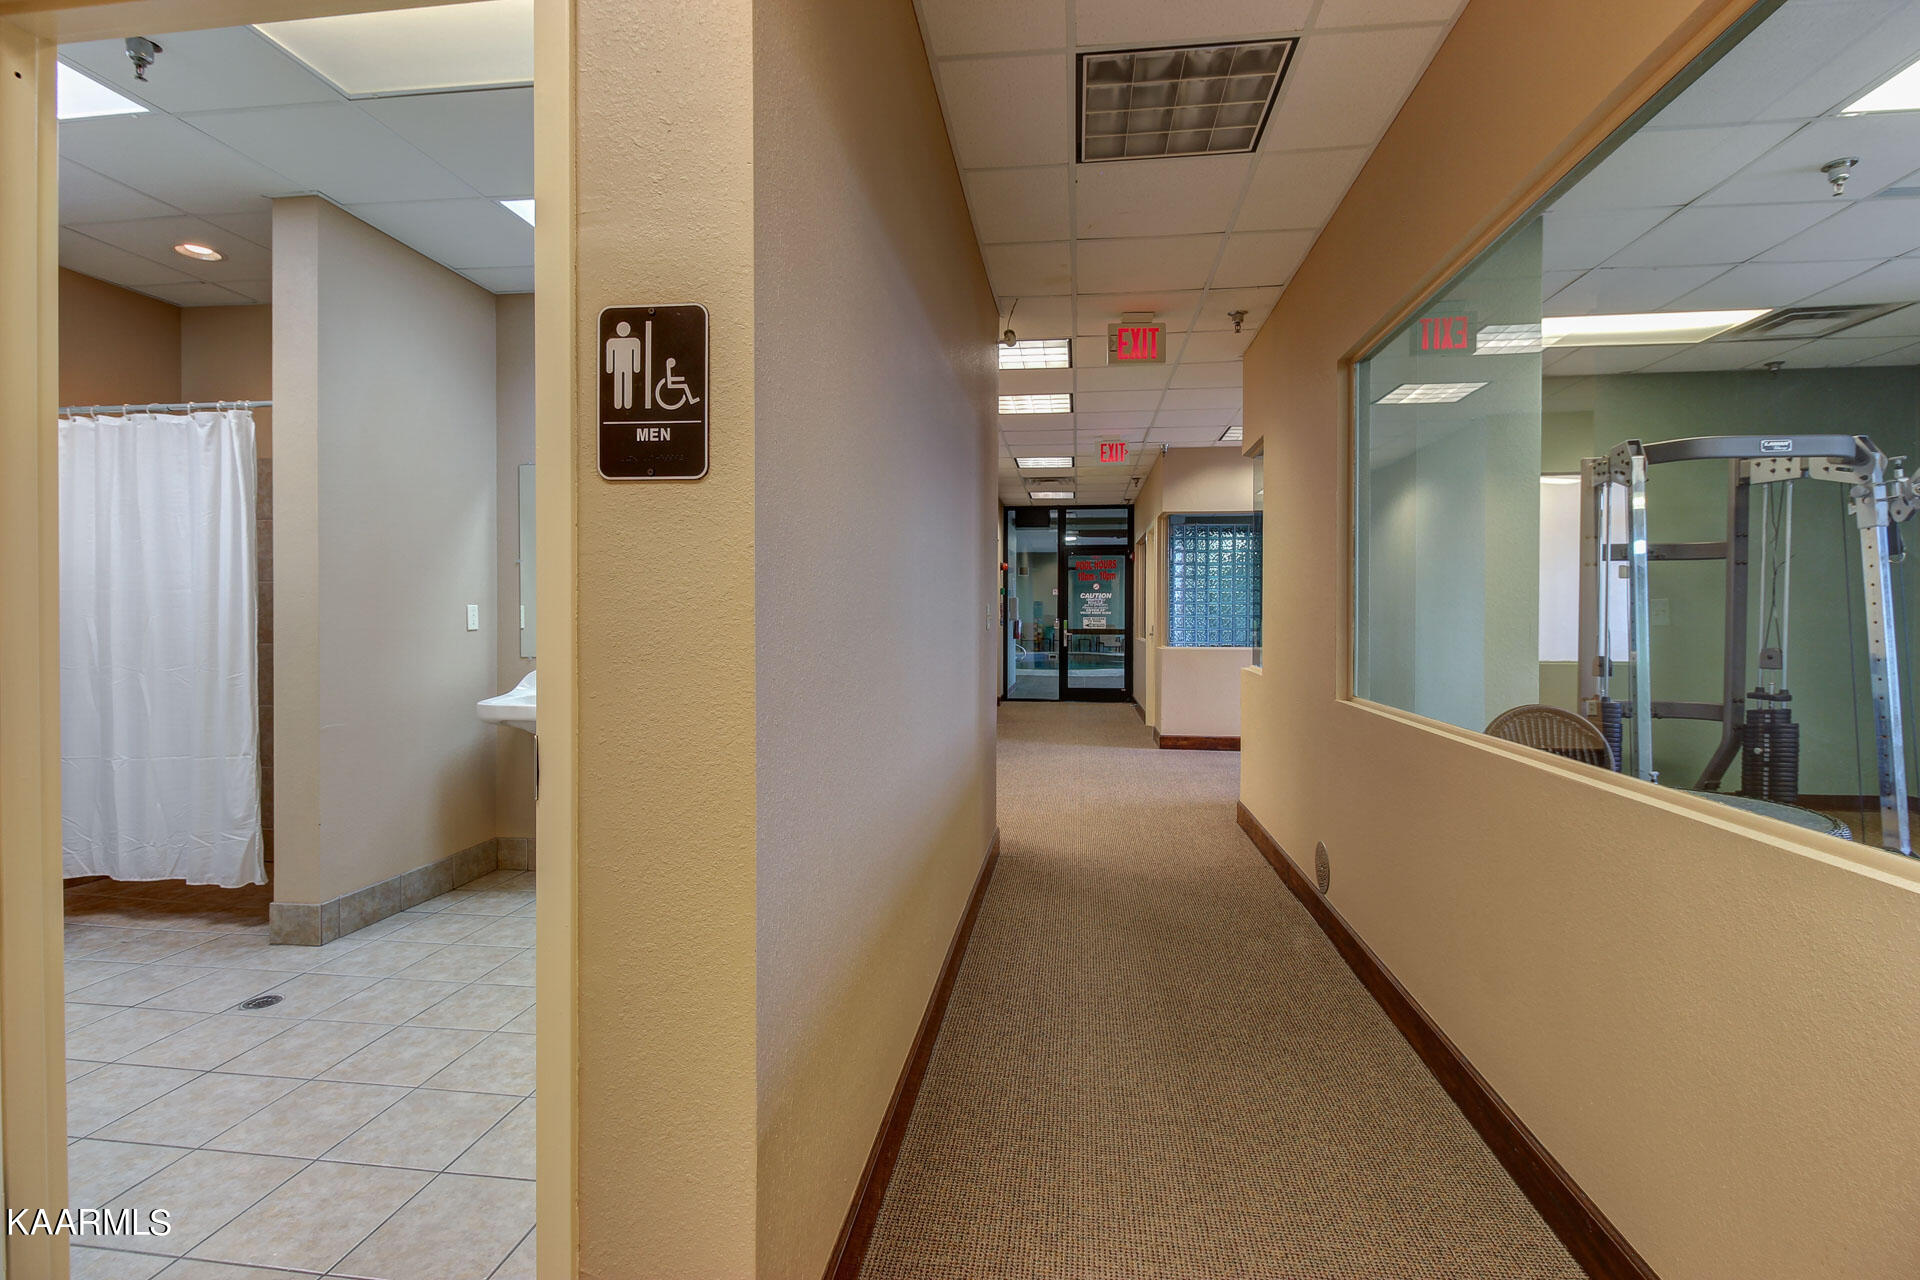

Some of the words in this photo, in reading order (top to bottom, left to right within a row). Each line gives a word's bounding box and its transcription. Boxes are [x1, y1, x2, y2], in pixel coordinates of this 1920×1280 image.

[1117, 327, 1160, 360] EXIT
[636, 427, 671, 442] MEN
[1100, 443, 1126, 463] EXIT
[1075, 560, 1094, 570] POOL
[1094, 559, 1117, 570] HOURS
